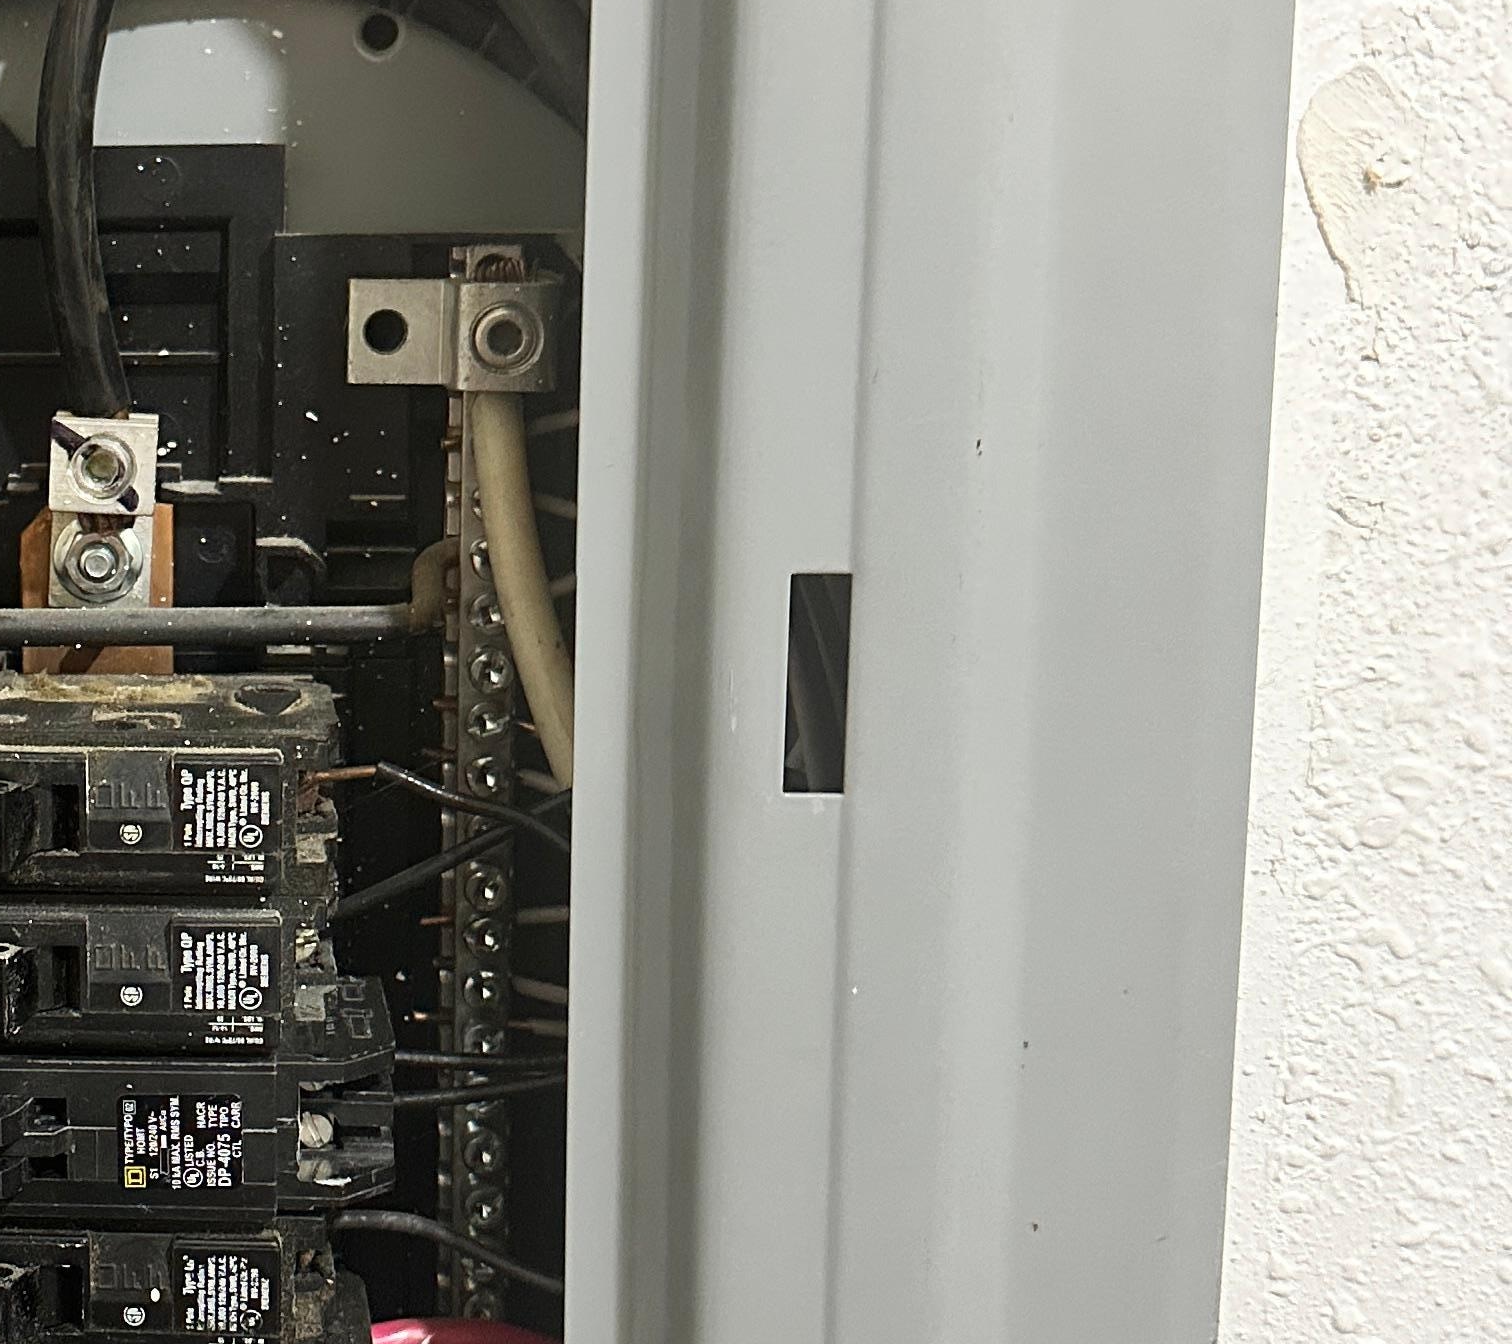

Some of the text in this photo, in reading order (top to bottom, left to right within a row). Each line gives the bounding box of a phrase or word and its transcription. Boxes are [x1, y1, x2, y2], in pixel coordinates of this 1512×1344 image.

[196, 1101, 207, 1128] HACR
[208, 1104, 218, 1128] TYPE
[231, 1101, 242, 1158] CTL CARR
[183, 1134, 194, 1167] LISTED
[217, 1106, 232, 1187] DP-4075 TIPO
